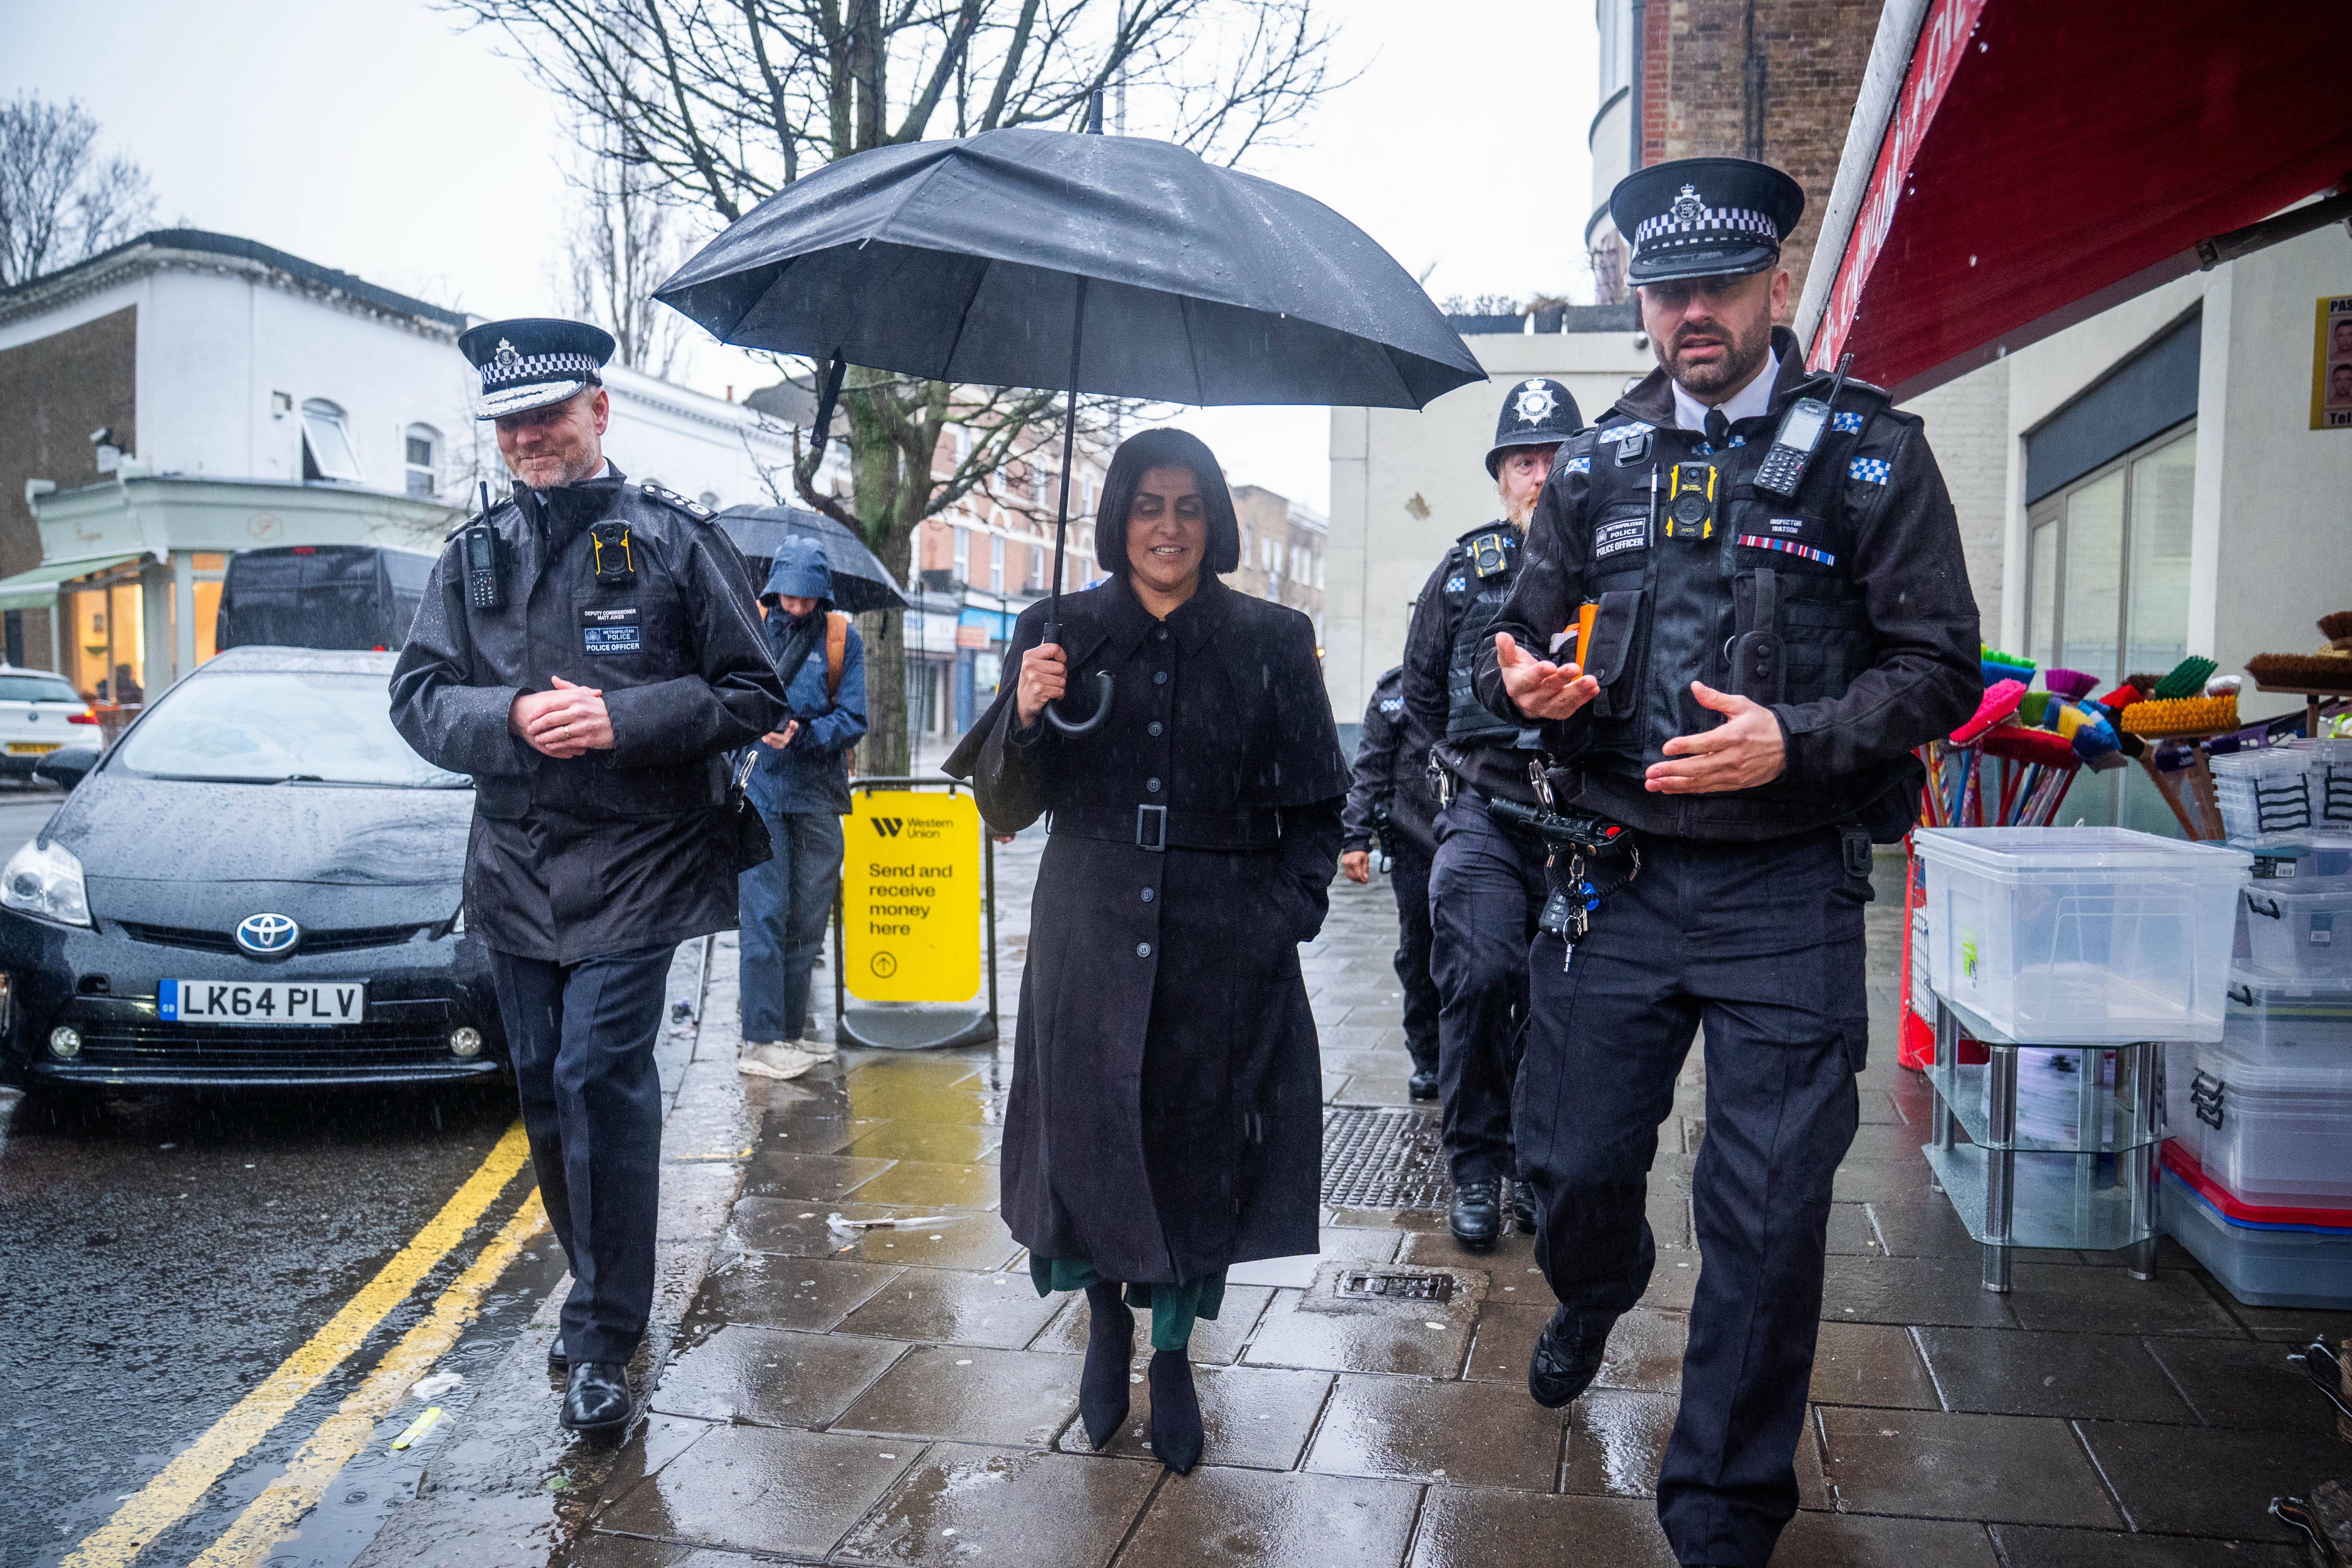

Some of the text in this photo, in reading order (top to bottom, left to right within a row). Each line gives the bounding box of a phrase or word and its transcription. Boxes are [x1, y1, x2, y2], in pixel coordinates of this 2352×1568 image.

[1607, 521, 1643, 532] METROPOLITAN
[1610, 529, 1637, 539] POLICE
[1597, 538, 1644, 557] POLICE OFFICER
[907, 818, 953, 827] Western
[907, 828, 940, 838] Union
[869, 863, 953, 878] Send and
[869, 883, 935, 897] receive
[869, 904, 931, 919] money
[870, 921, 911, 935] here
[184, 985, 355, 1017] LK64 PLV
